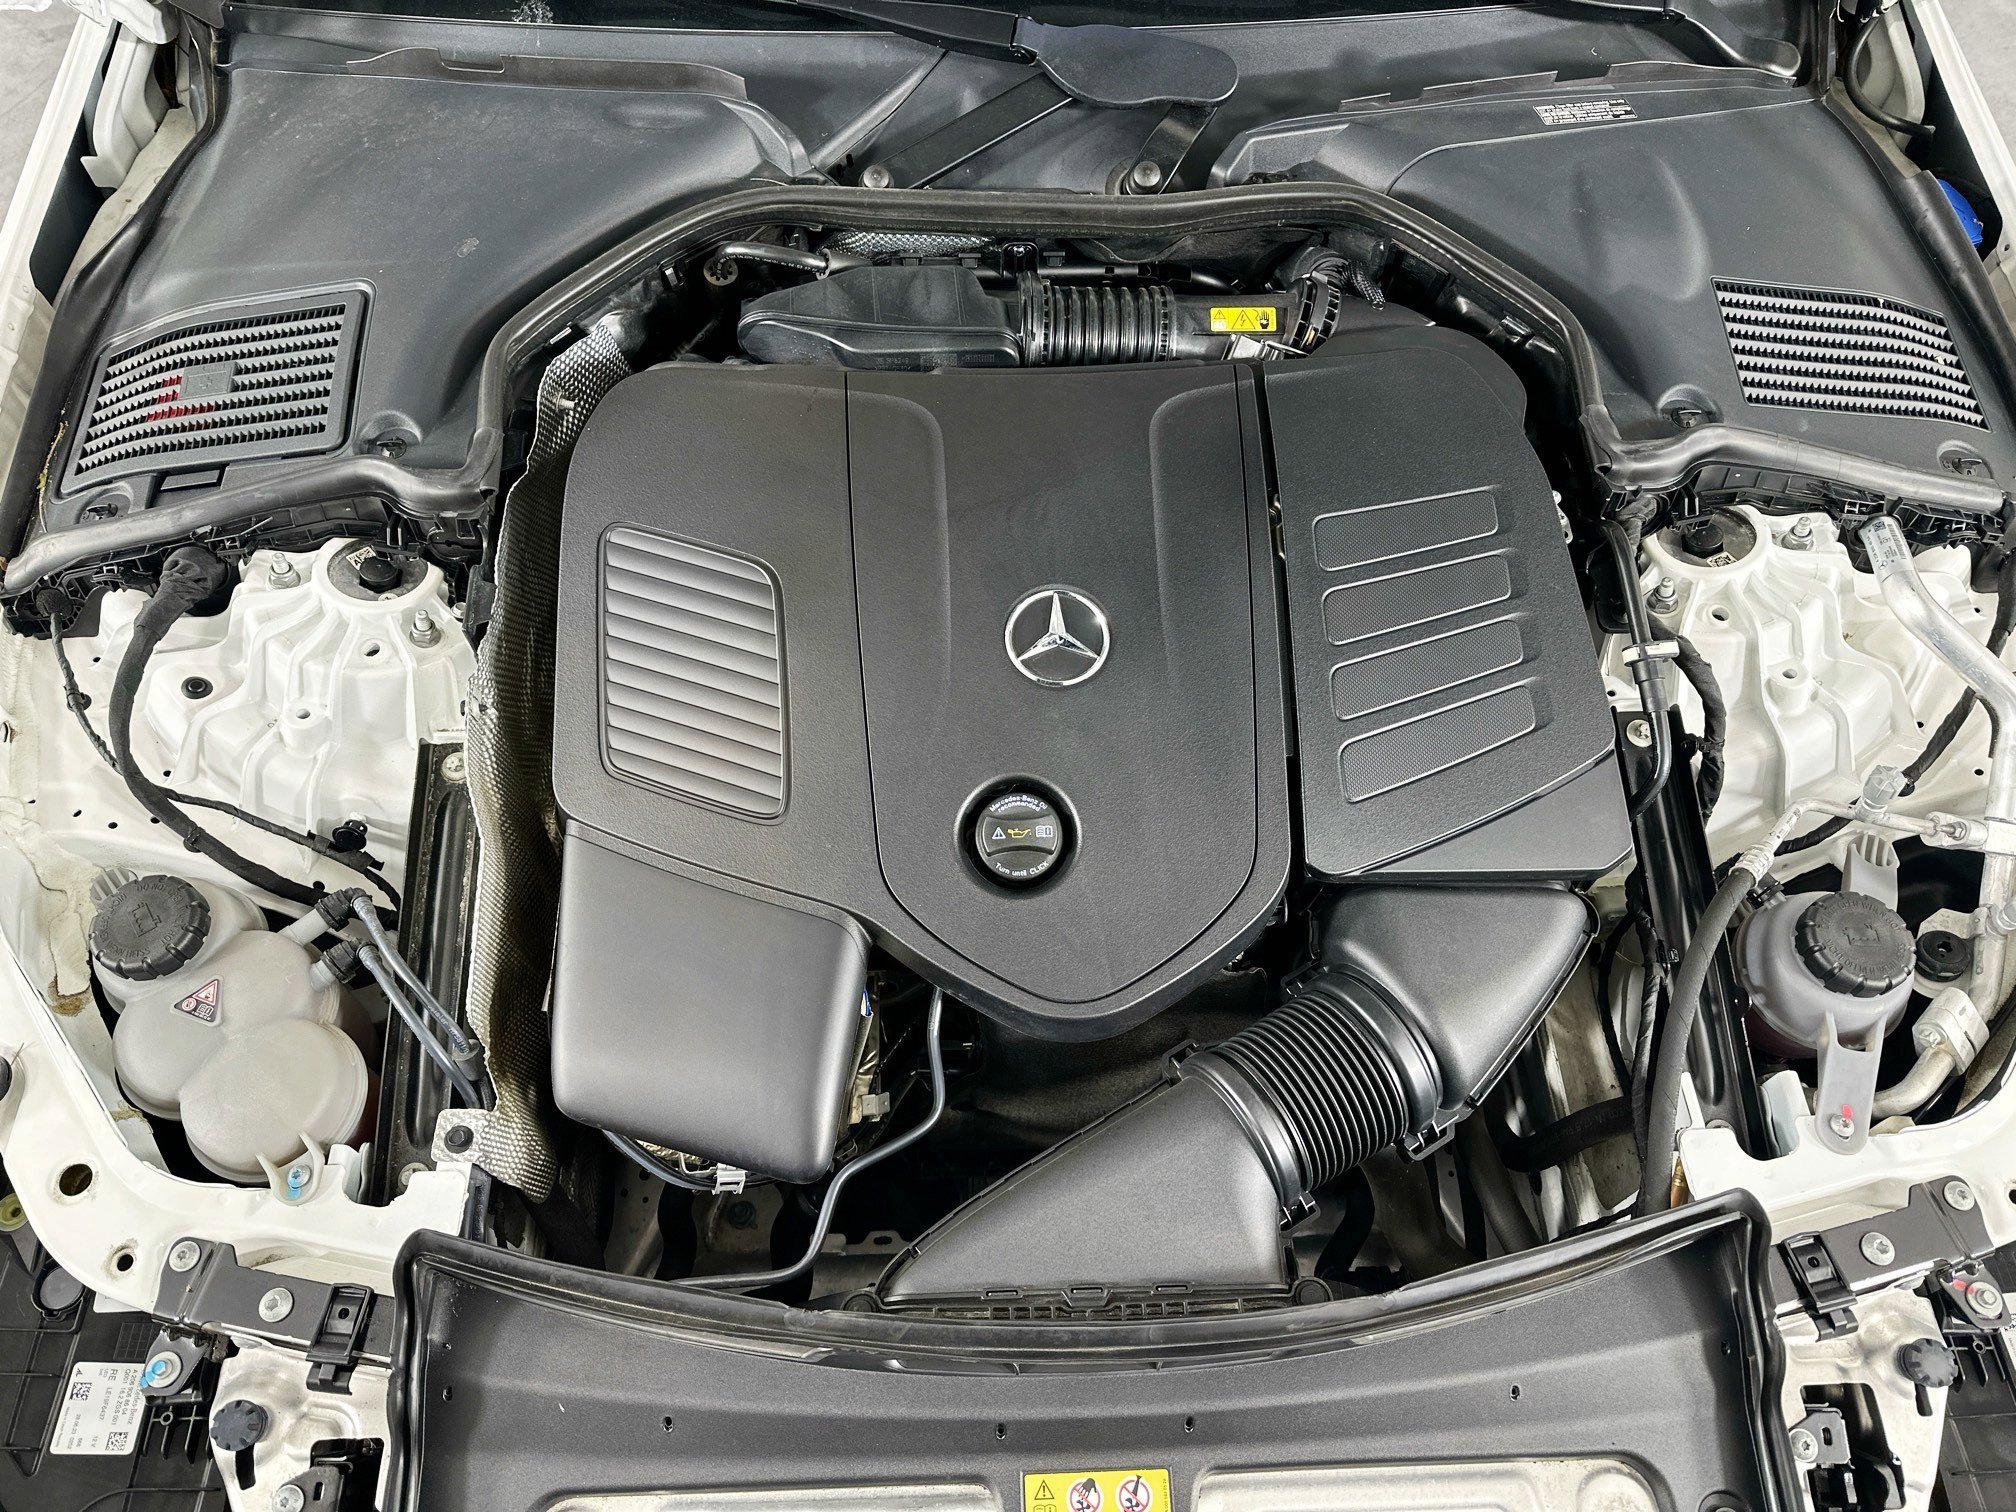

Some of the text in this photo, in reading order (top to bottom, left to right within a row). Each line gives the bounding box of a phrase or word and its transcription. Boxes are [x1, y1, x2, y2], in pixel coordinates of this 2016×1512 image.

[989, 795, 1038, 812] Mercedes-Benz
[995, 862, 1010, 875] Turn
[1029, 861, 1049, 875] CLICK
[108, 1368, 118, 1381] RE
